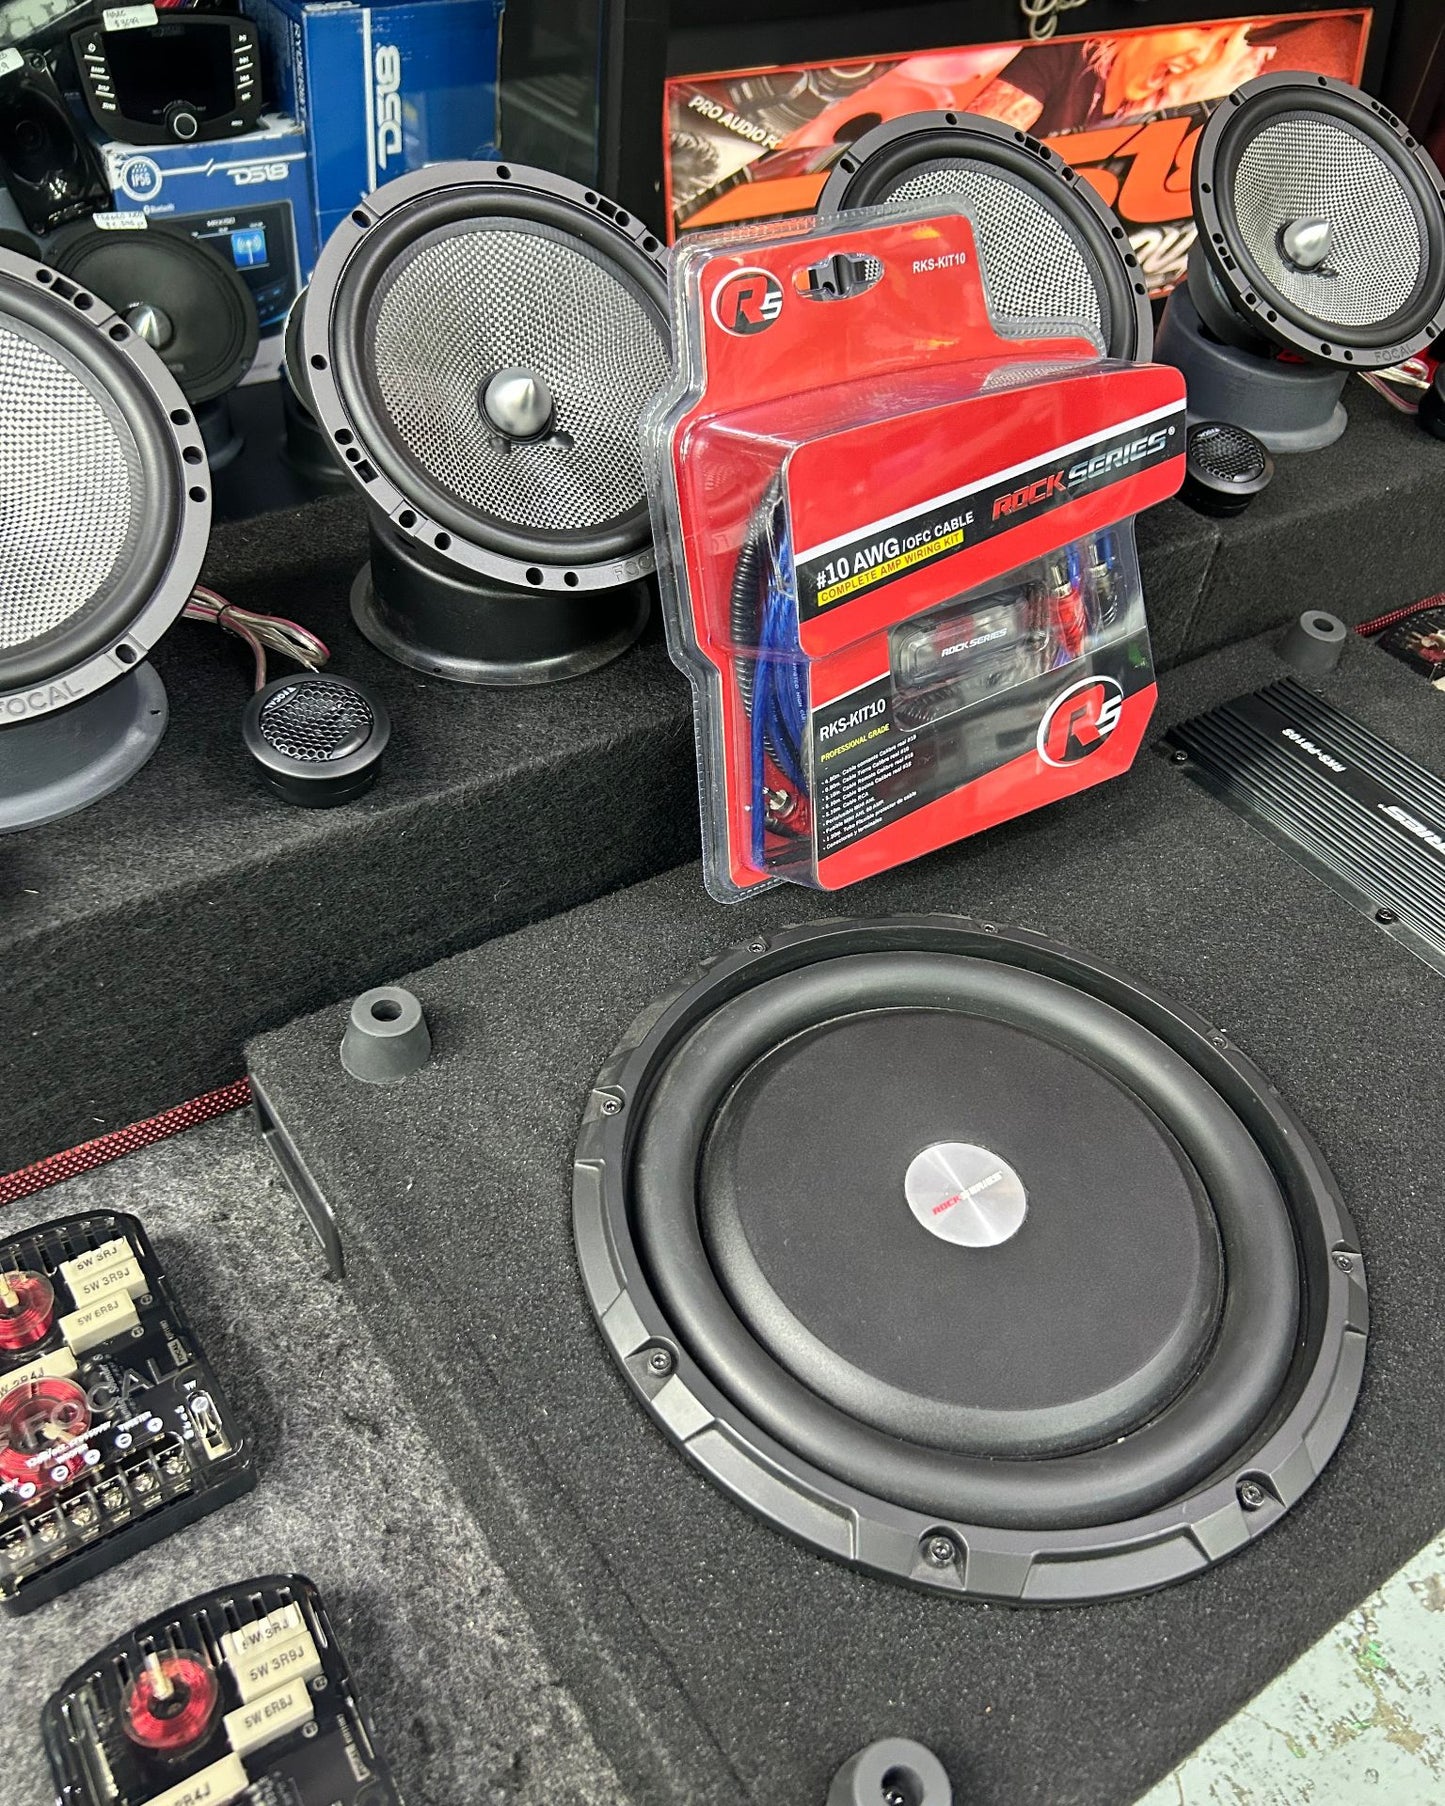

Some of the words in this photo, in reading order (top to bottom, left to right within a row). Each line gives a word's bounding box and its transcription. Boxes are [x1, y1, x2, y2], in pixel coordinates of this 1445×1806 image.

[375, 44, 402, 171] DS18
[687, 95, 723, 120] PRO
[717, 112, 767, 143] AUDIO
[131, 171, 151, 188] IP56
[226, 162, 290, 186] DS18
[912, 251, 967, 275] RKS-KIT10
[1374, 343, 1416, 363] FOCAL
[991, 470, 1067, 521] ROCK
[1067, 428, 1168, 488] SERIES
[815, 556, 851, 590] #10
[852, 536, 901, 574] AWG
[901, 529, 932, 553] /OFC
[934, 511, 975, 537] CABLE
[820, 569, 877, 602] COMPLETE
[879, 558, 902, 577] AMP
[903, 541, 942, 565] WIRING
[943, 532, 961, 547] KIT
[941, 640, 969, 658] ROCK
[969, 627, 1008, 648] SERIES
[819, 698, 887, 742] RKS-KIT10
[820, 735, 868, 763] PROFESSIONAL
[867, 723, 890, 739] GRADE
[842, 765, 857, 776] Cable
[879, 745, 897, 757] Calibre
[897, 739, 907, 748] real
[842, 773, 857, 784] Cable
[872, 757, 890, 769] Calibre
[889, 750, 900, 760] real
[842, 781, 857, 792] Cable
[876, 762, 894, 775] Calibre
[894, 756, 904, 766] real
[842, 790, 857, 800] Cable
[874, 771, 892, 784] Calibre
[892, 765, 902, 775] real
[842, 798, 857, 808] Cable
[857, 791, 869, 801] RCA
[843, 823, 856, 833] Tubo
[903, 791, 917, 801] cable
[931, 1194, 962, 1216] ROCK
[76, 1257, 94, 1271] 5W
[96, 1247, 118, 1262] 3RJ
[83, 1279, 100, 1294] 5W
[102, 1267, 130, 1287] 3R9J
[77, 1314, 93, 1326] 5W
[265, 1617, 290, 1640] 3RJ
[249, 1663, 269, 1682] 5W
[272, 1646, 305, 1671] 3R9J
[244, 1712, 262, 1729] 5W
